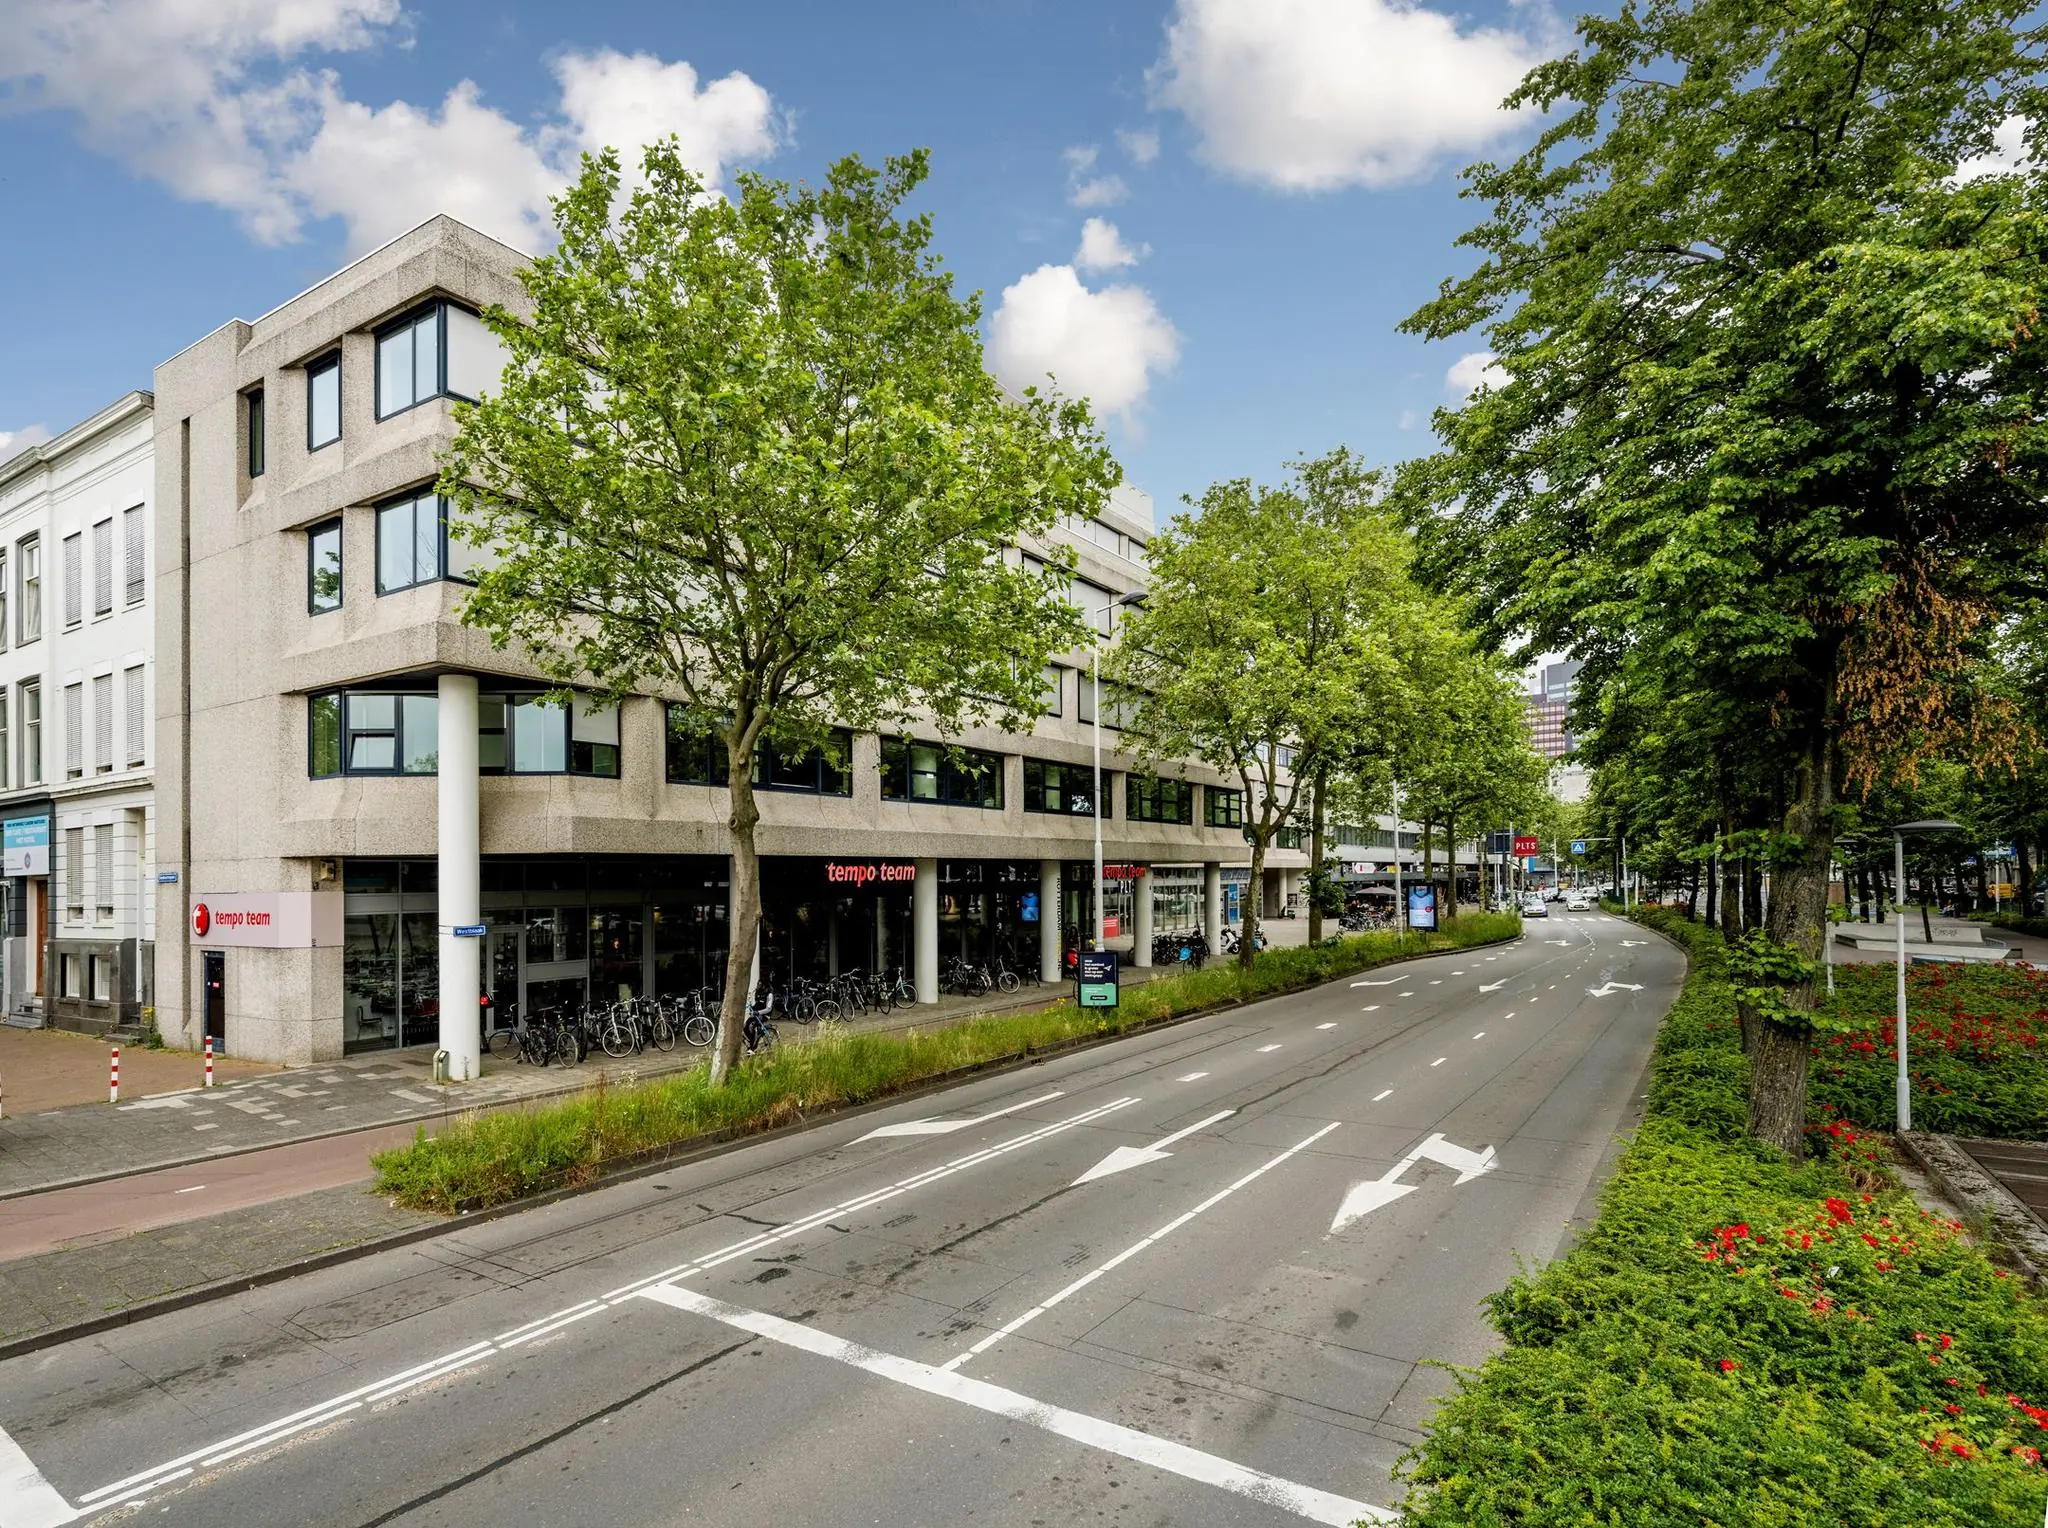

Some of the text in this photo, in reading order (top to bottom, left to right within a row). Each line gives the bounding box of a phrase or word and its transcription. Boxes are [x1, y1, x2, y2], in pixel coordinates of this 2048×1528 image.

[1516, 842, 1536, 850] PLTS
[828, 862, 916, 887] tempo team
[215, 910, 271, 930] tempo team
